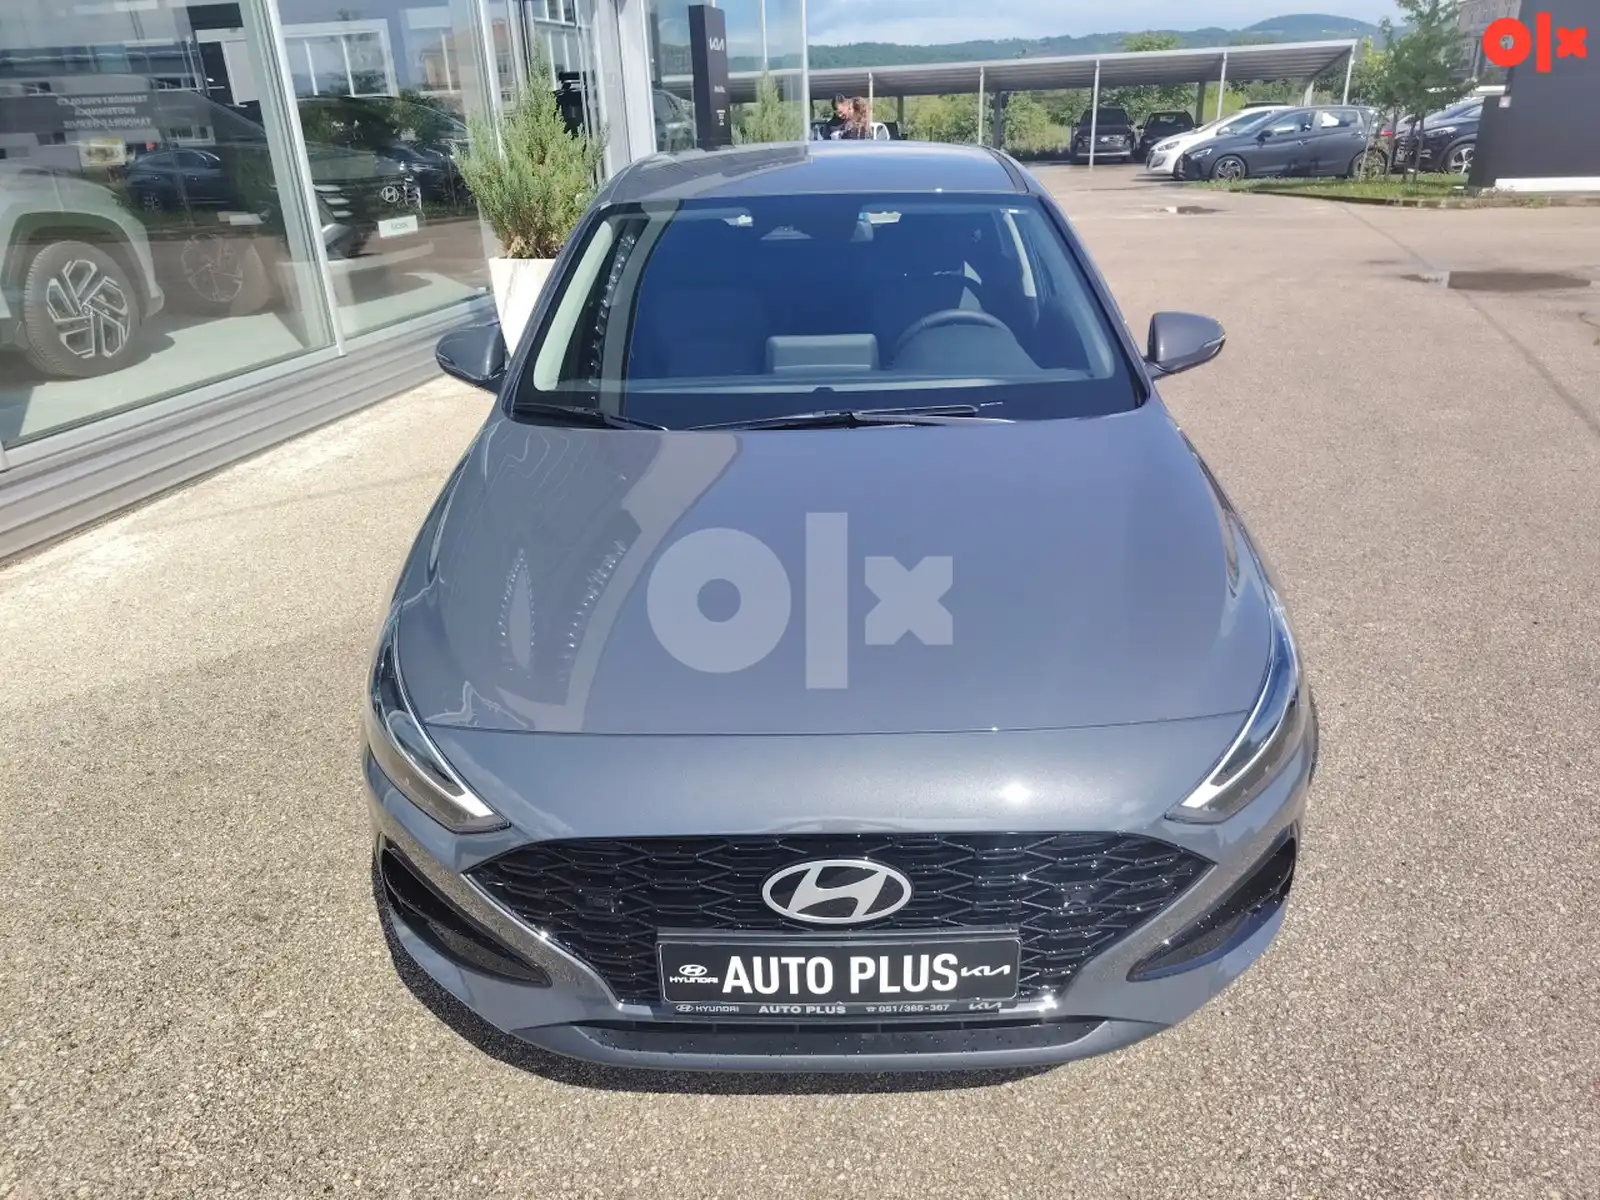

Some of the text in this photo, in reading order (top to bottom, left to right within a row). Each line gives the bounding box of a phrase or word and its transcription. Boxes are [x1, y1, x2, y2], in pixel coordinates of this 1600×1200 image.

[722, 953, 959, 994] AUTO PLUS
[960, 964, 1011, 977] KIA
[669, 976, 719, 984] HYUNDAI
[696, 1005, 739, 1013] HYUNDAI
[758, 1005, 801, 1014] AUTO
[806, 1005, 846, 1014] PLUS
